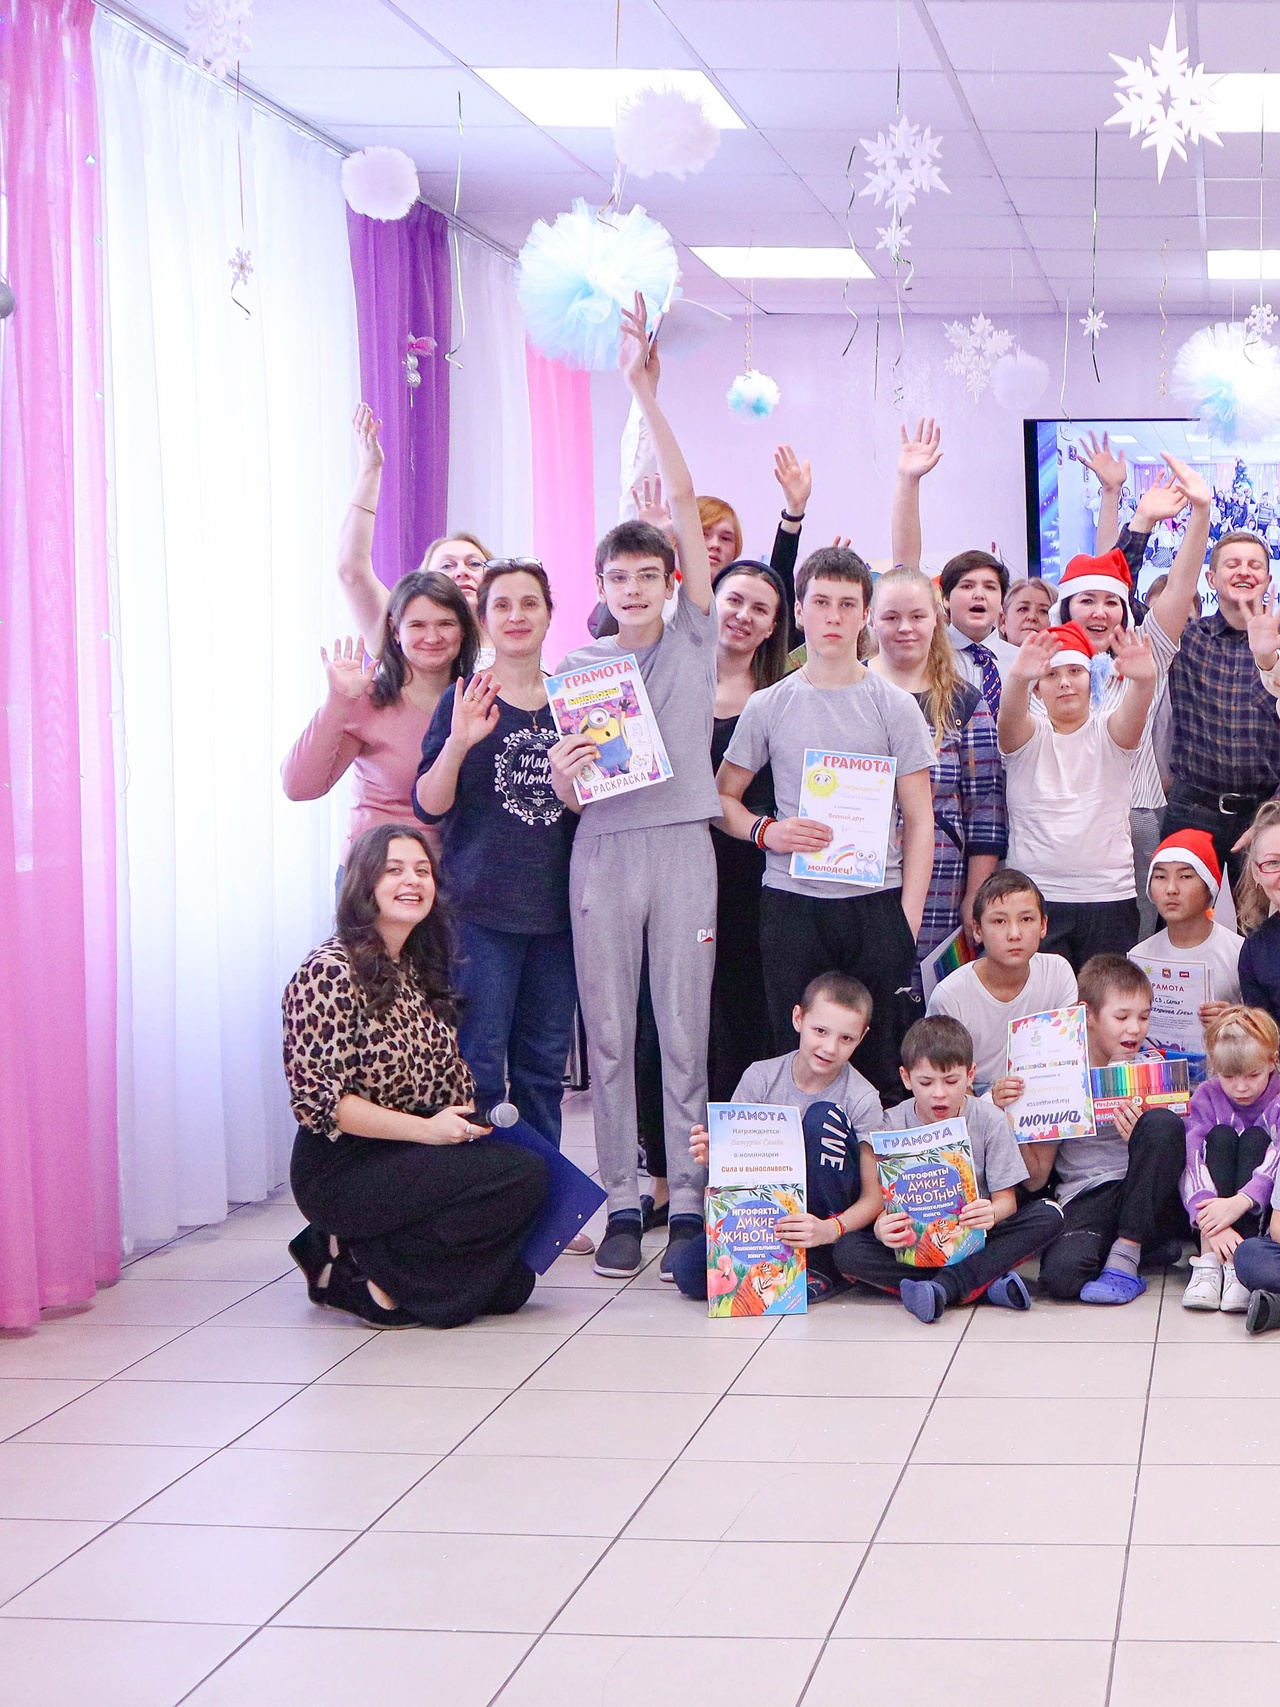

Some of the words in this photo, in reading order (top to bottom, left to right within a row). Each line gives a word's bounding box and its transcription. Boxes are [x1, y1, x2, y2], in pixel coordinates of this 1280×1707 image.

[564, 660, 634, 689] ГРАМОТА
[519, 753, 551, 773] Mag
[823, 755, 891, 773] ГРАМОТА
[511, 770, 552, 785] Mome
[593, 772, 648, 795] РАСКРАСКА
[828, 812, 851, 822] Верный
[807, 864, 854, 875] молодец!
[697, 929, 714, 943] CA
[1152, 983, 1185, 992] РАМОТА
[719, 1109, 788, 1121] ГРАМОТА
[1019, 1110, 1081, 1128] ДИПЛОМ
[882, 1127, 953, 1148] ГРАМОТА
[902, 1167, 949, 1180] ИГРОФАКТЫ
[908, 1178, 946, 1192] ДИКИЕ
[896, 1182, 964, 1204] ЖИВОТНЫЕ
[732, 1207, 779, 1216] ИГРОФАКТЫ
[736, 1218, 774, 1230] ДИКИЕ
[720, 1229, 777, 1244] ЖИВОТН
